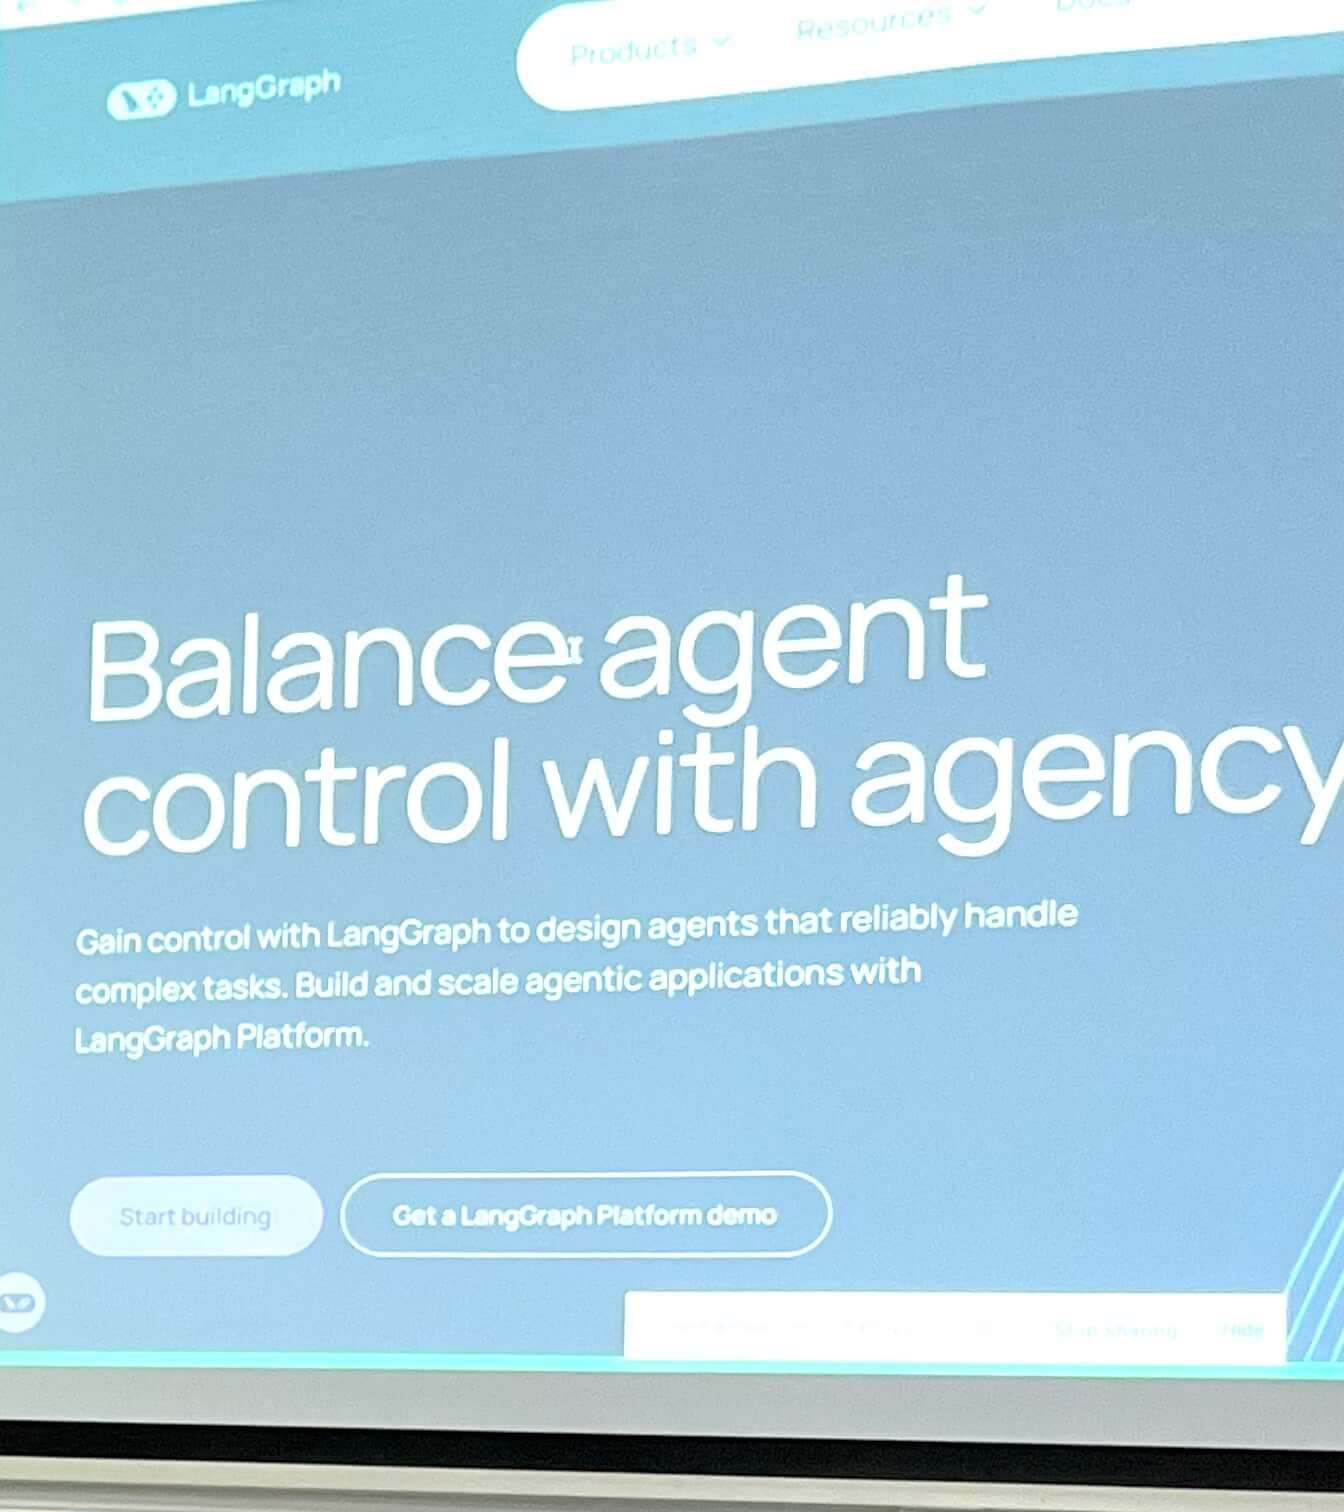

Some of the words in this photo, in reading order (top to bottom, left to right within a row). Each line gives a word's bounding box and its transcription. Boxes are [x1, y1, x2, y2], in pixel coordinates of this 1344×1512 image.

[796, 8, 953, 41] Resources
[570, 36, 698, 67] Products
[187, 67, 342, 109] LangGraph
[91, 613, 582, 721] Balance
[601, 575, 987, 727] agent
[85, 737, 508, 855] control
[543, 726, 816, 838] with
[852, 726, 1344, 856] agency
[77, 928, 141, 955] Gain
[148, 924, 250, 953] control
[257, 921, 320, 949] with
[328, 918, 491, 953] LangGraph
[498, 918, 529, 944] to
[537, 913, 640, 948] design
[649, 911, 758, 945] agents
[765, 907, 832, 934] that
[841, 902, 957, 937] reliably
[965, 899, 1078, 929] handle
[76, 976, 196, 1010] complex
[203, 974, 288, 1001] tasks.
[296, 970, 368, 998] Build
[375, 969, 431, 997] and
[439, 967, 518, 996] scale
[526, 964, 641, 999] agentic
[649, 959, 844, 996] applications
[851, 957, 921, 985] with
[76, 1024, 230, 1060] LangGraph
[238, 1021, 369, 1049] Platform.
[119, 1206, 175, 1227] Start
[181, 1206, 271, 1231] building
[392, 1204, 437, 1226] Get
[441, 1209, 457, 1226] a
[461, 1204, 592, 1233] LangGraph
[597, 1203, 702, 1227] Platform
[707, 1204, 778, 1226] demo
